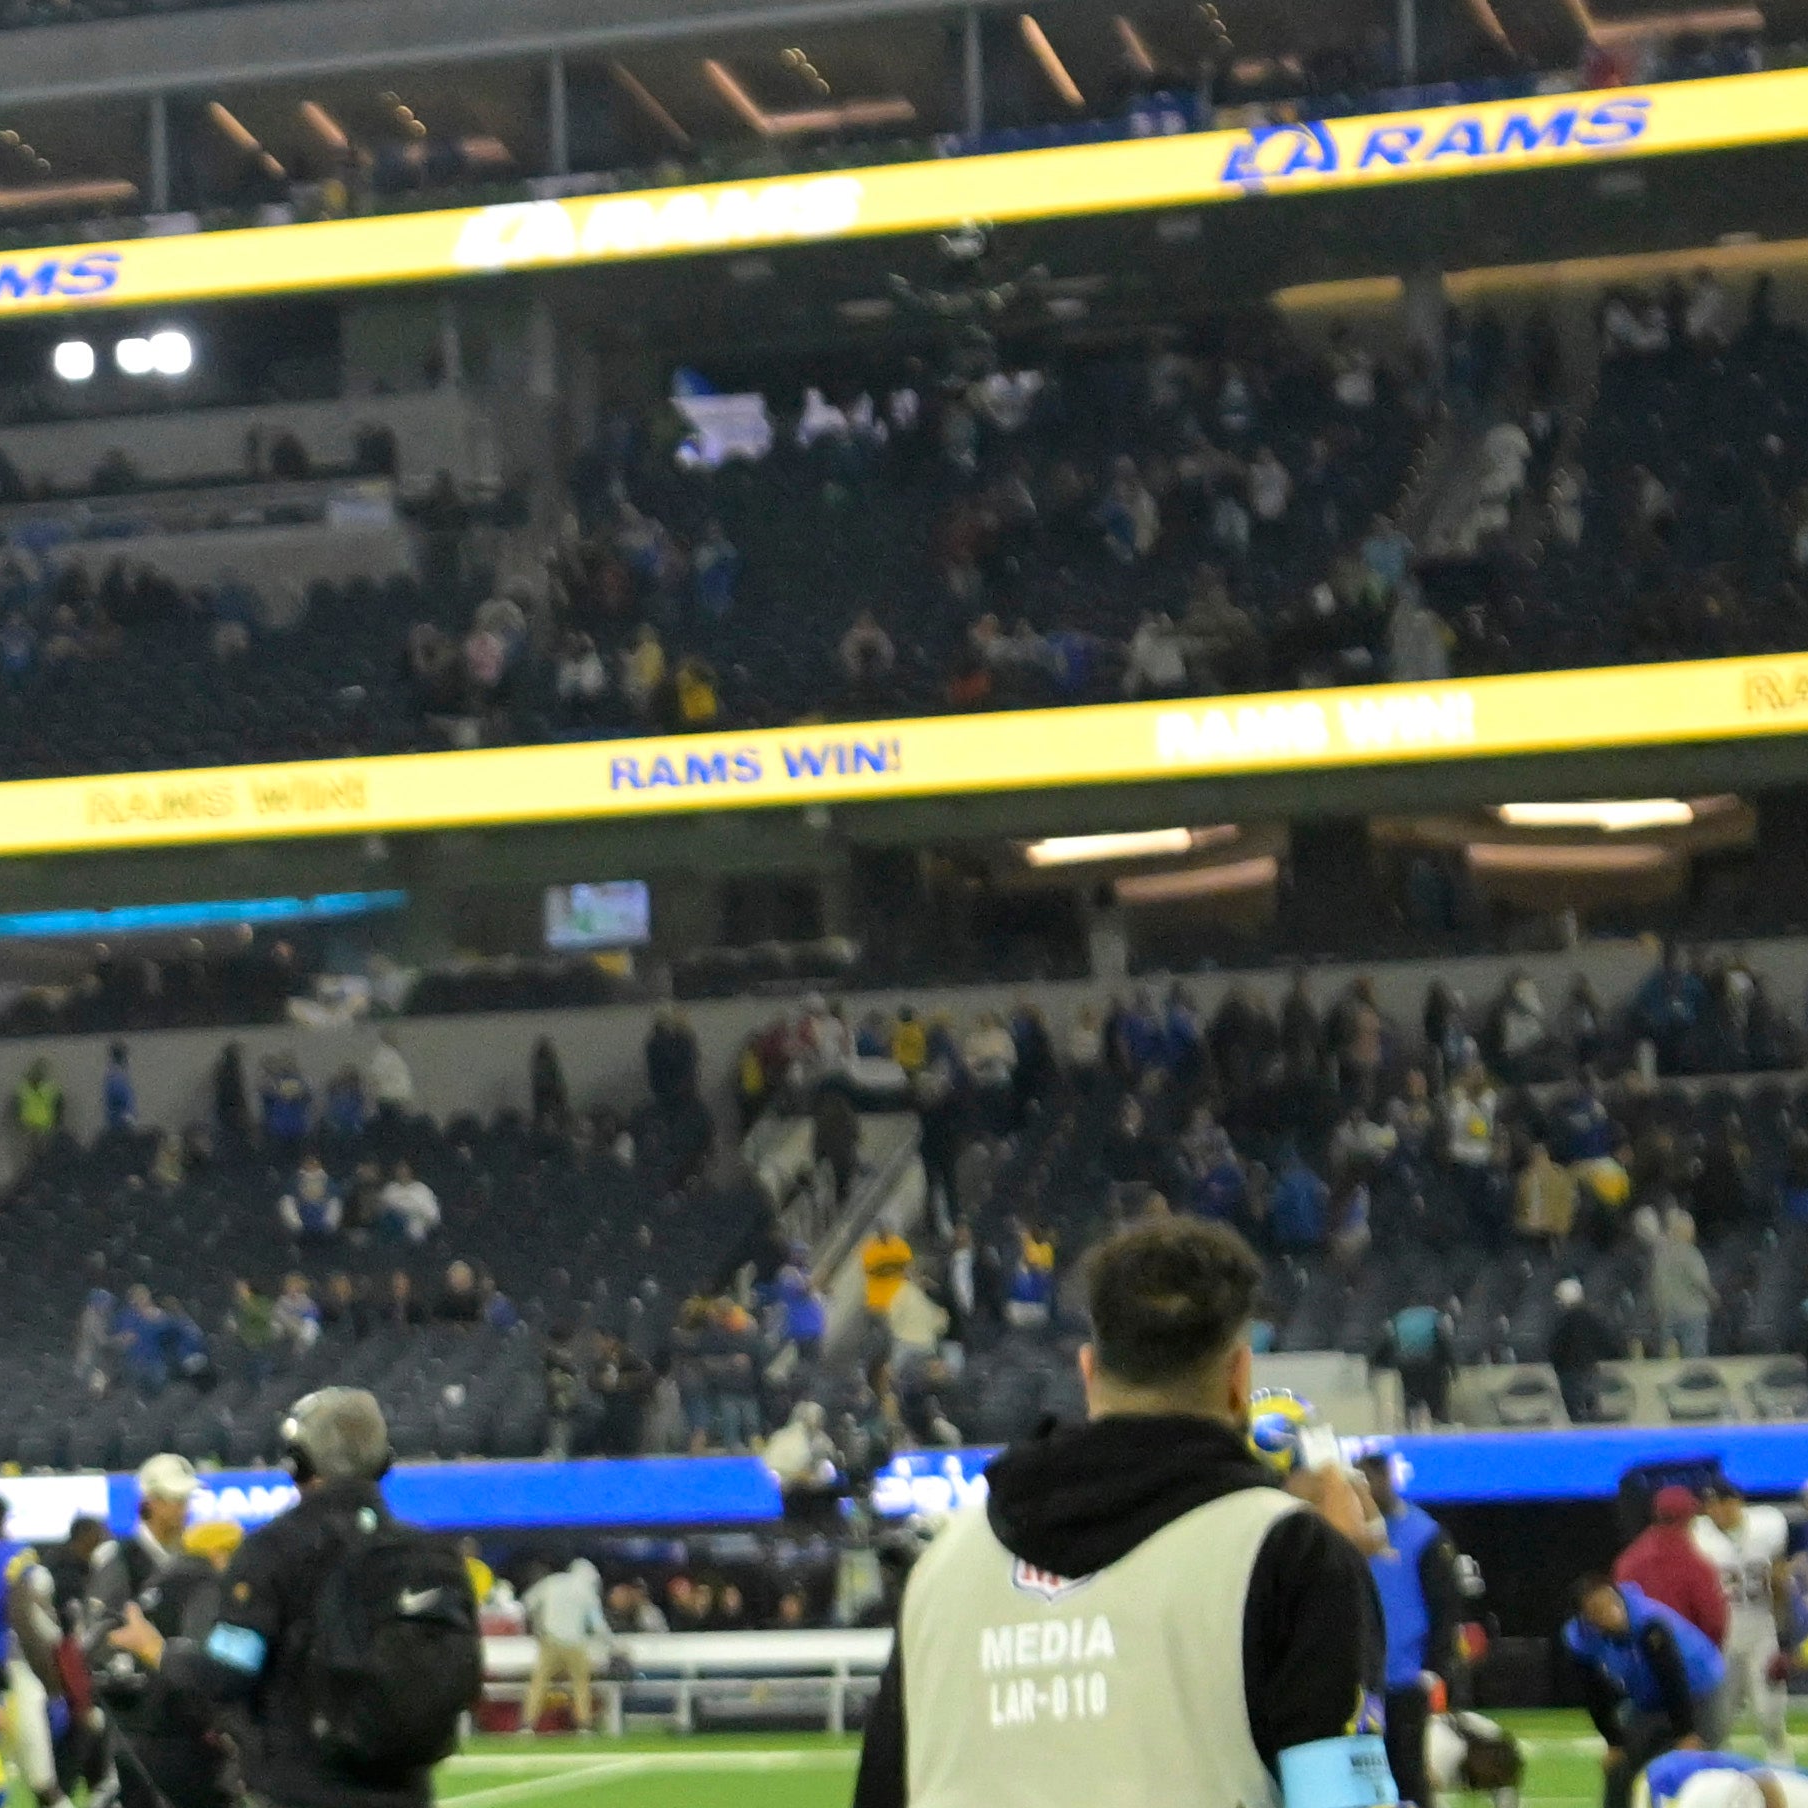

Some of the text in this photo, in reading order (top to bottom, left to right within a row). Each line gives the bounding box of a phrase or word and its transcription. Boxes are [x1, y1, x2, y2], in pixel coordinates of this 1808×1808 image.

[1359, 98, 1651, 170] RAMS
[610, 739, 899, 790] RAMS WIN!
[981, 1614, 1116, 1674] MEDIA
[990, 1671, 1108, 1729] LAR-010
